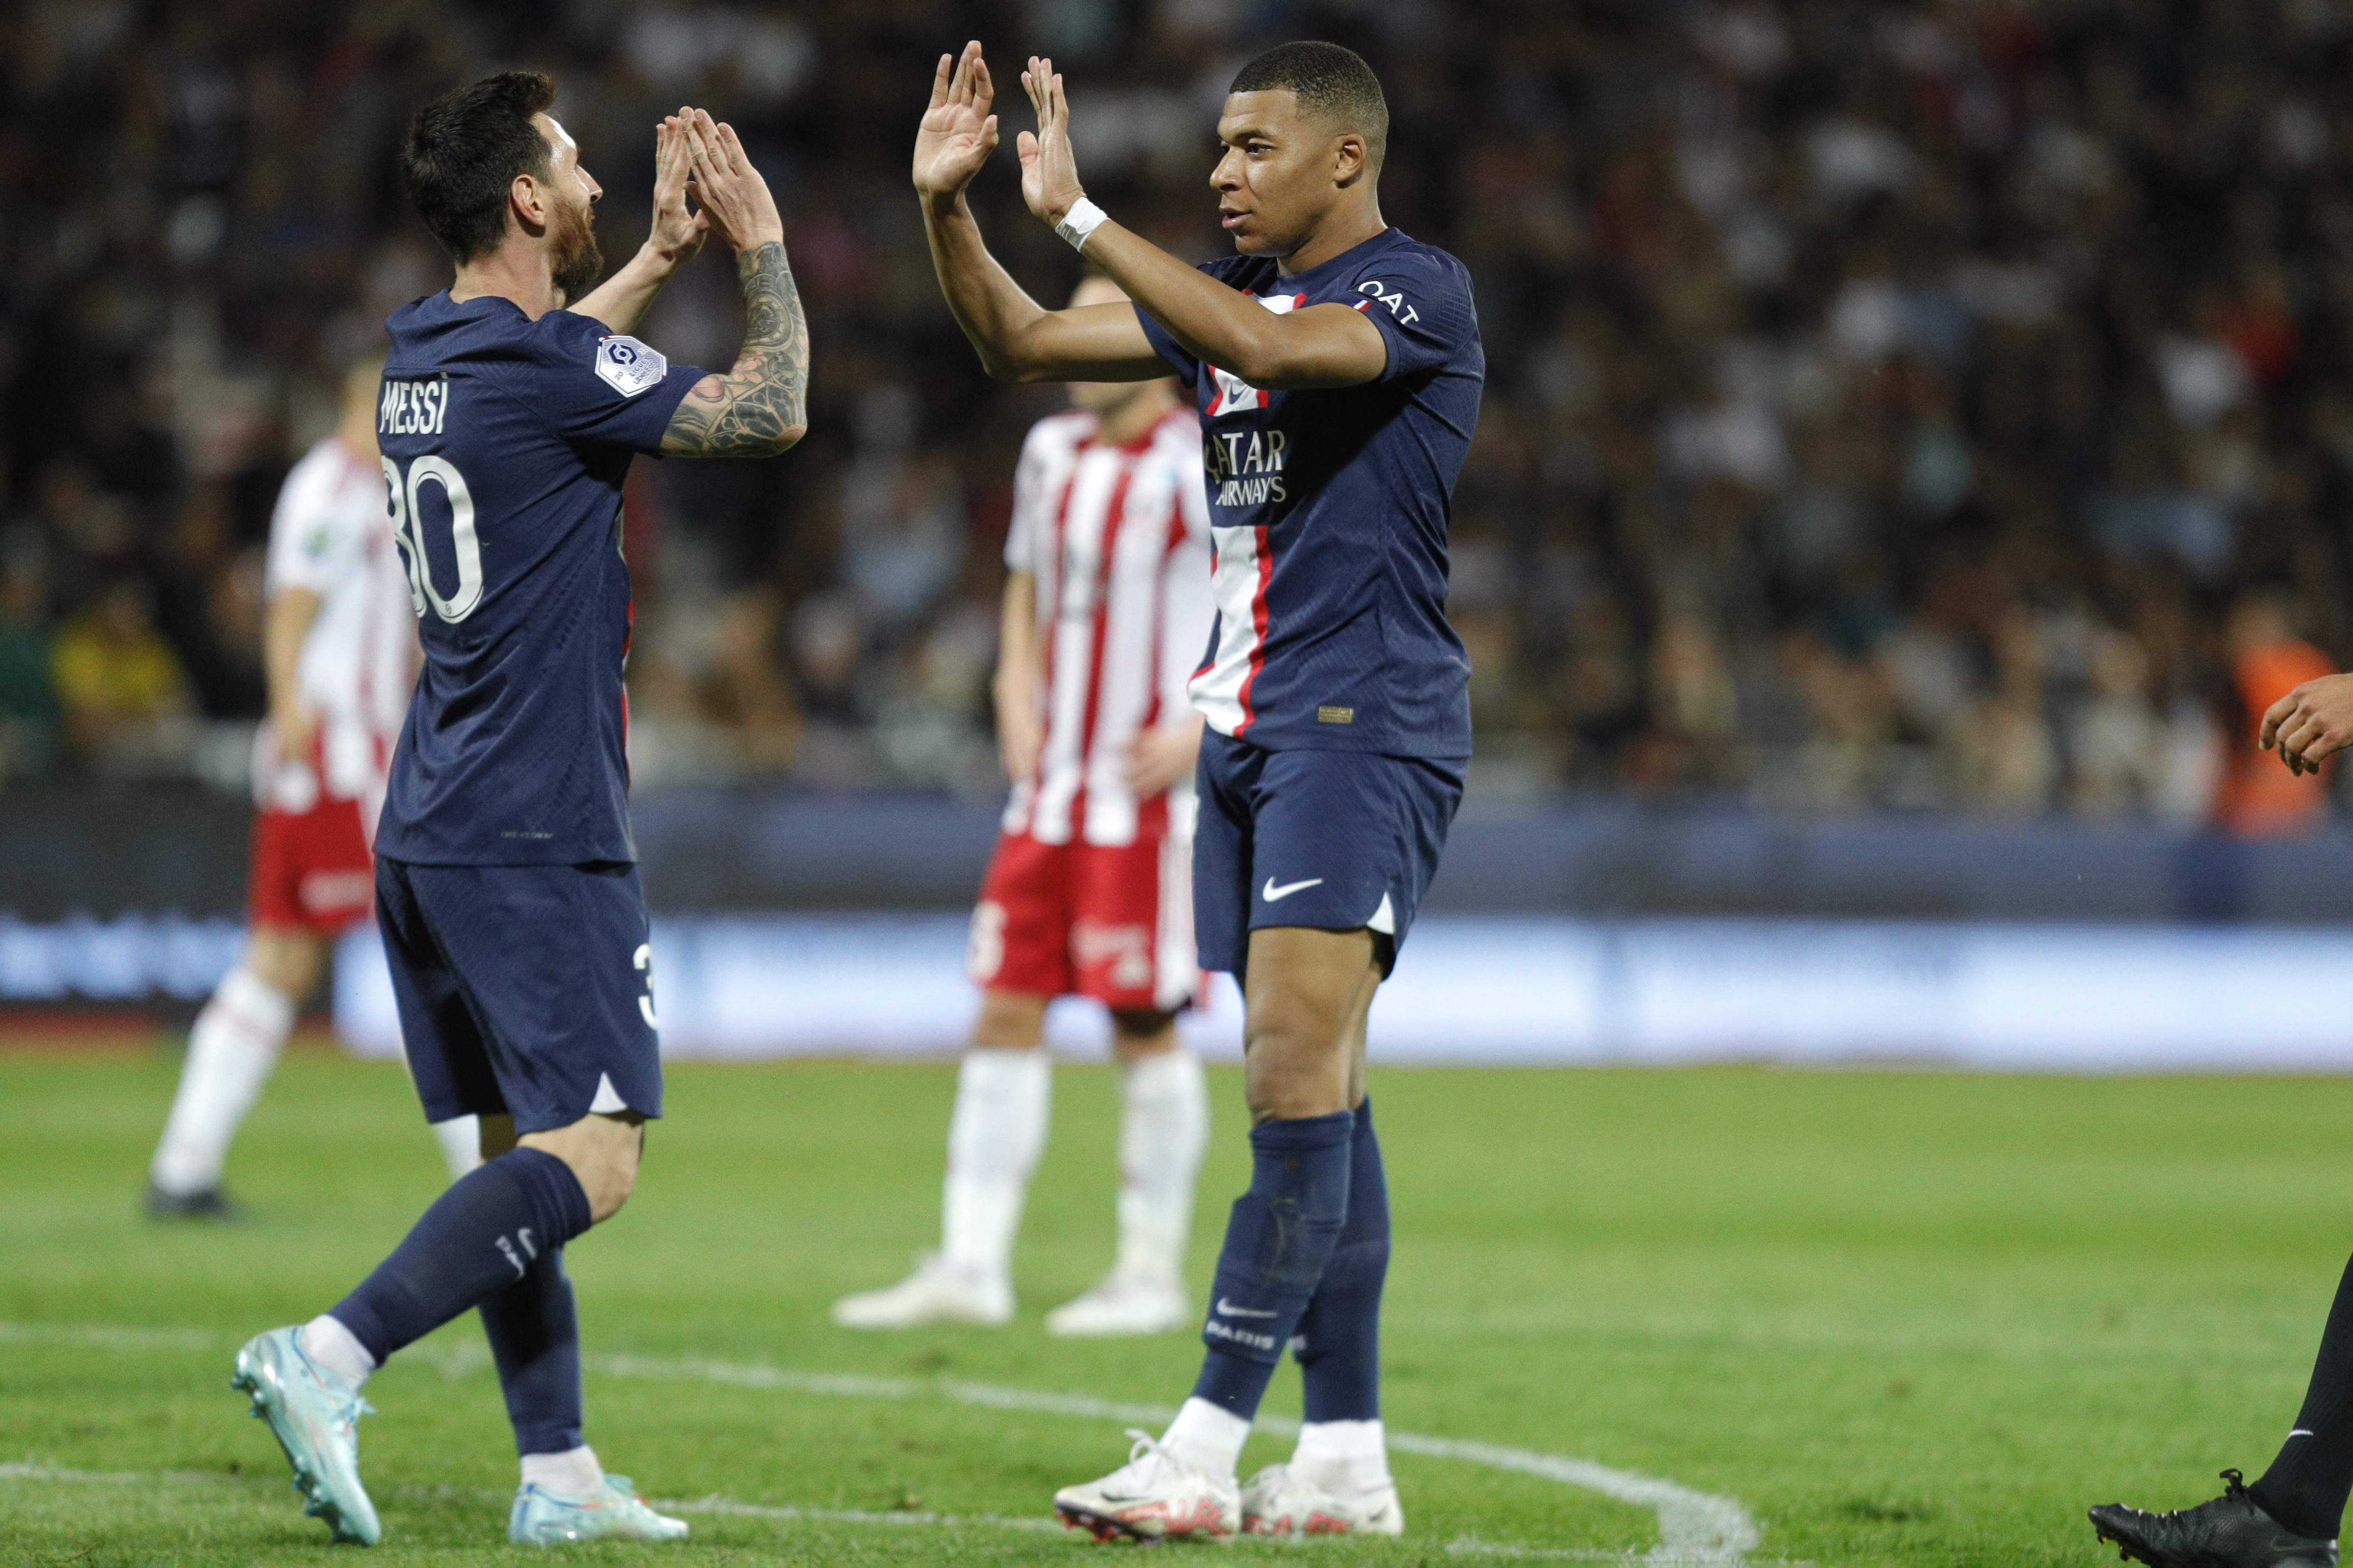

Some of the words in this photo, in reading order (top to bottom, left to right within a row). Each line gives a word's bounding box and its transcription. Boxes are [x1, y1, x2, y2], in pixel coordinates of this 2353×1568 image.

[1349, 280, 1420, 324] OAT
[379, 374, 448, 434] MESSI
[1215, 476, 1287, 507] AIRWAYS
[381, 455, 484, 625] 30
[633, 944, 658, 1030] 3
